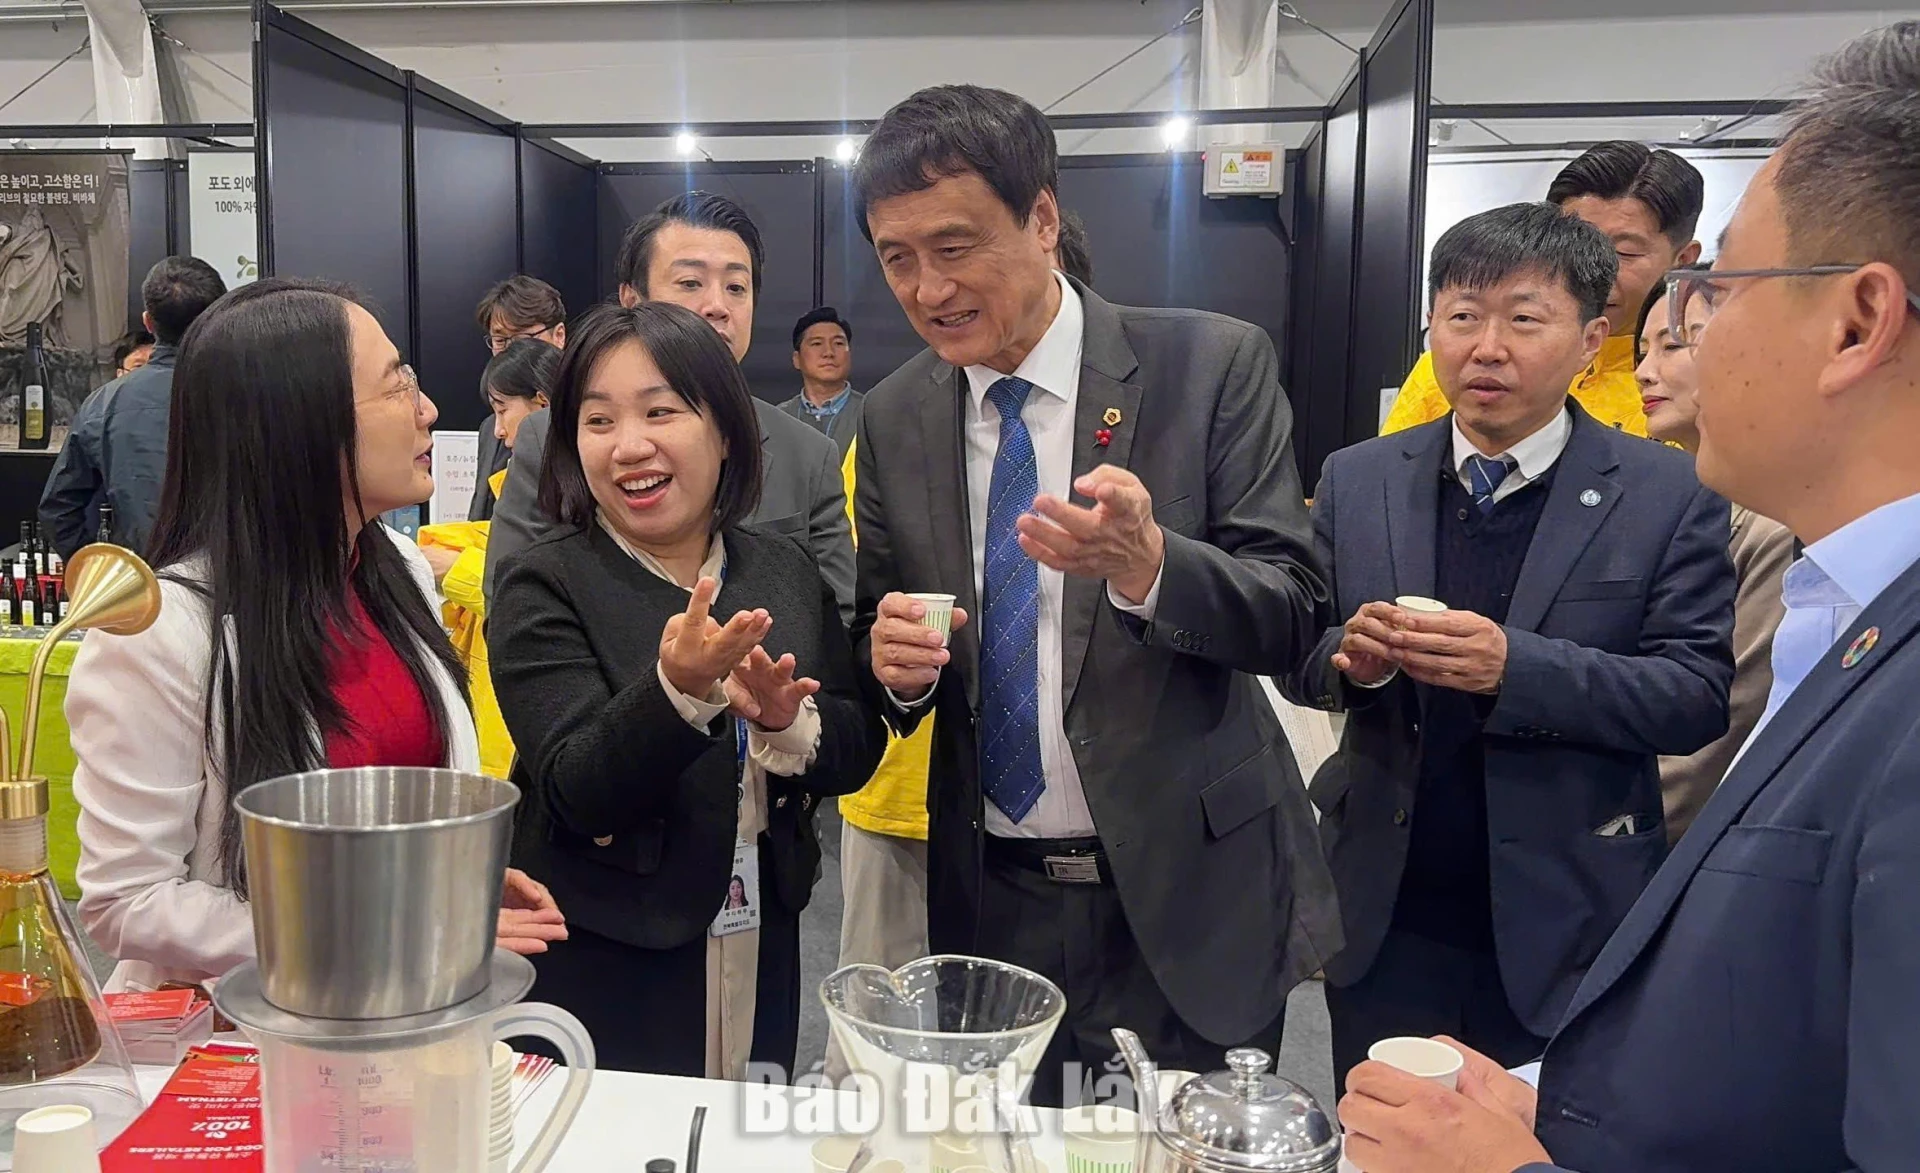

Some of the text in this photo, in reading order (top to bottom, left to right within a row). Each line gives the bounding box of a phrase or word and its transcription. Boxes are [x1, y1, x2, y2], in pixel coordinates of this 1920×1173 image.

[11, 174, 43, 189] 높이고,
[44, 174, 82, 189] 고소함은
[208, 176, 232, 190] 포도
[215, 200, 243, 213] 100%
[190, 1121, 251, 1132] 100%
